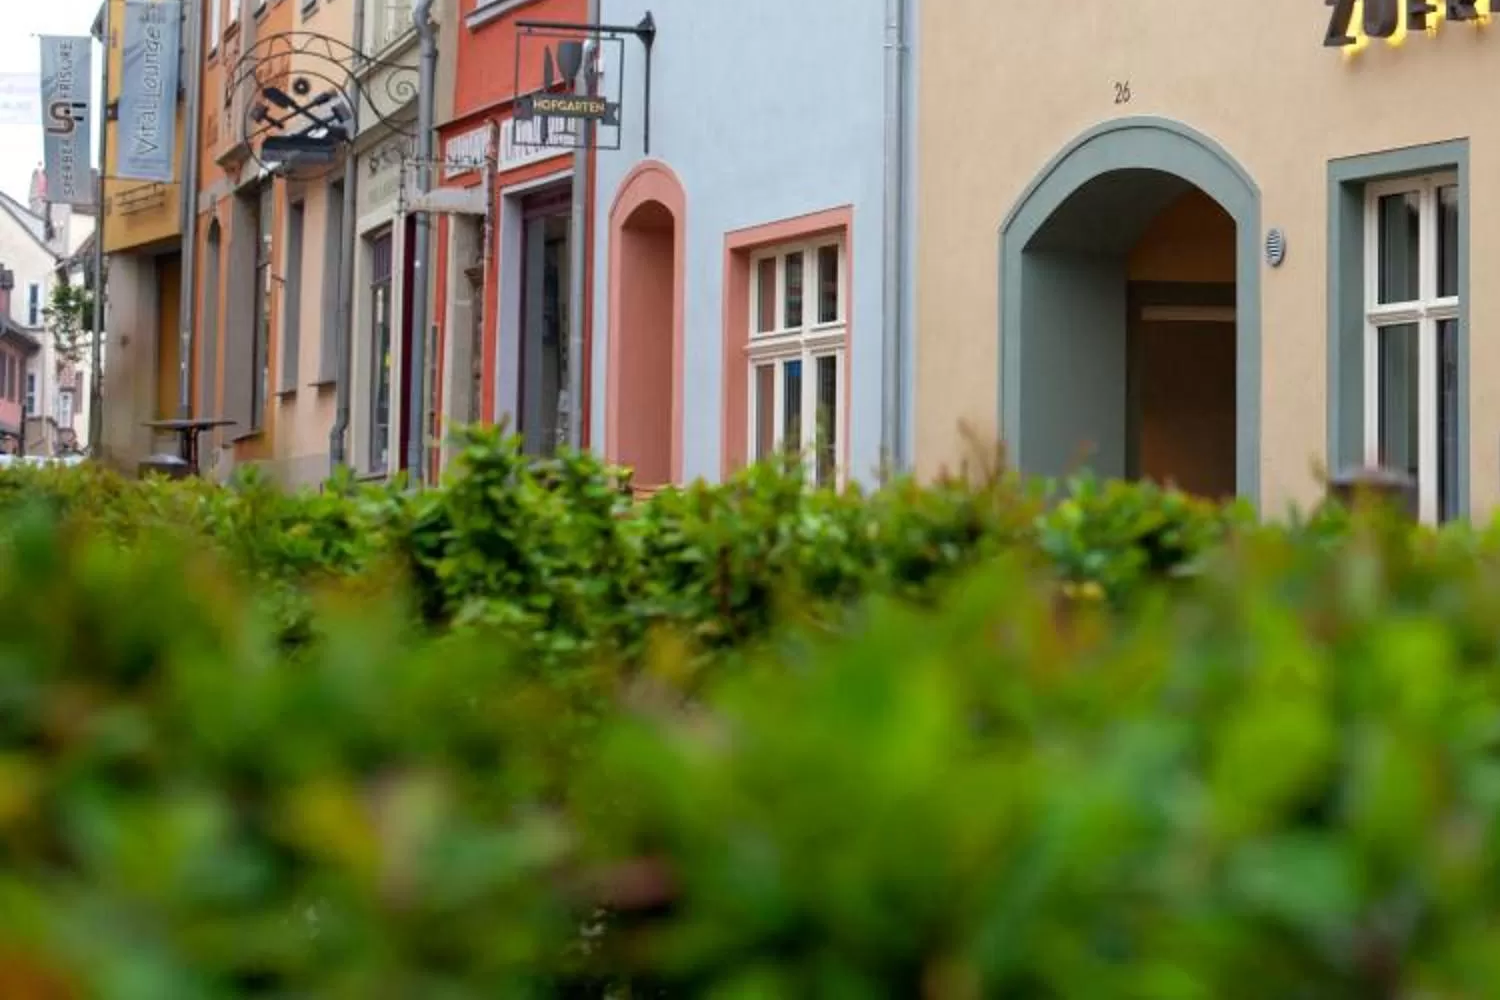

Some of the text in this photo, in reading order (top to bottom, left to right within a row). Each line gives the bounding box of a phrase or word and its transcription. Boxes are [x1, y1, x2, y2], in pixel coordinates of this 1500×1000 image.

[142, 27, 162, 99] Lounge
[533, 99, 605, 113] HOFGARTEN
[1113, 80, 1131, 105] 26
[135, 102, 159, 156] Vital
